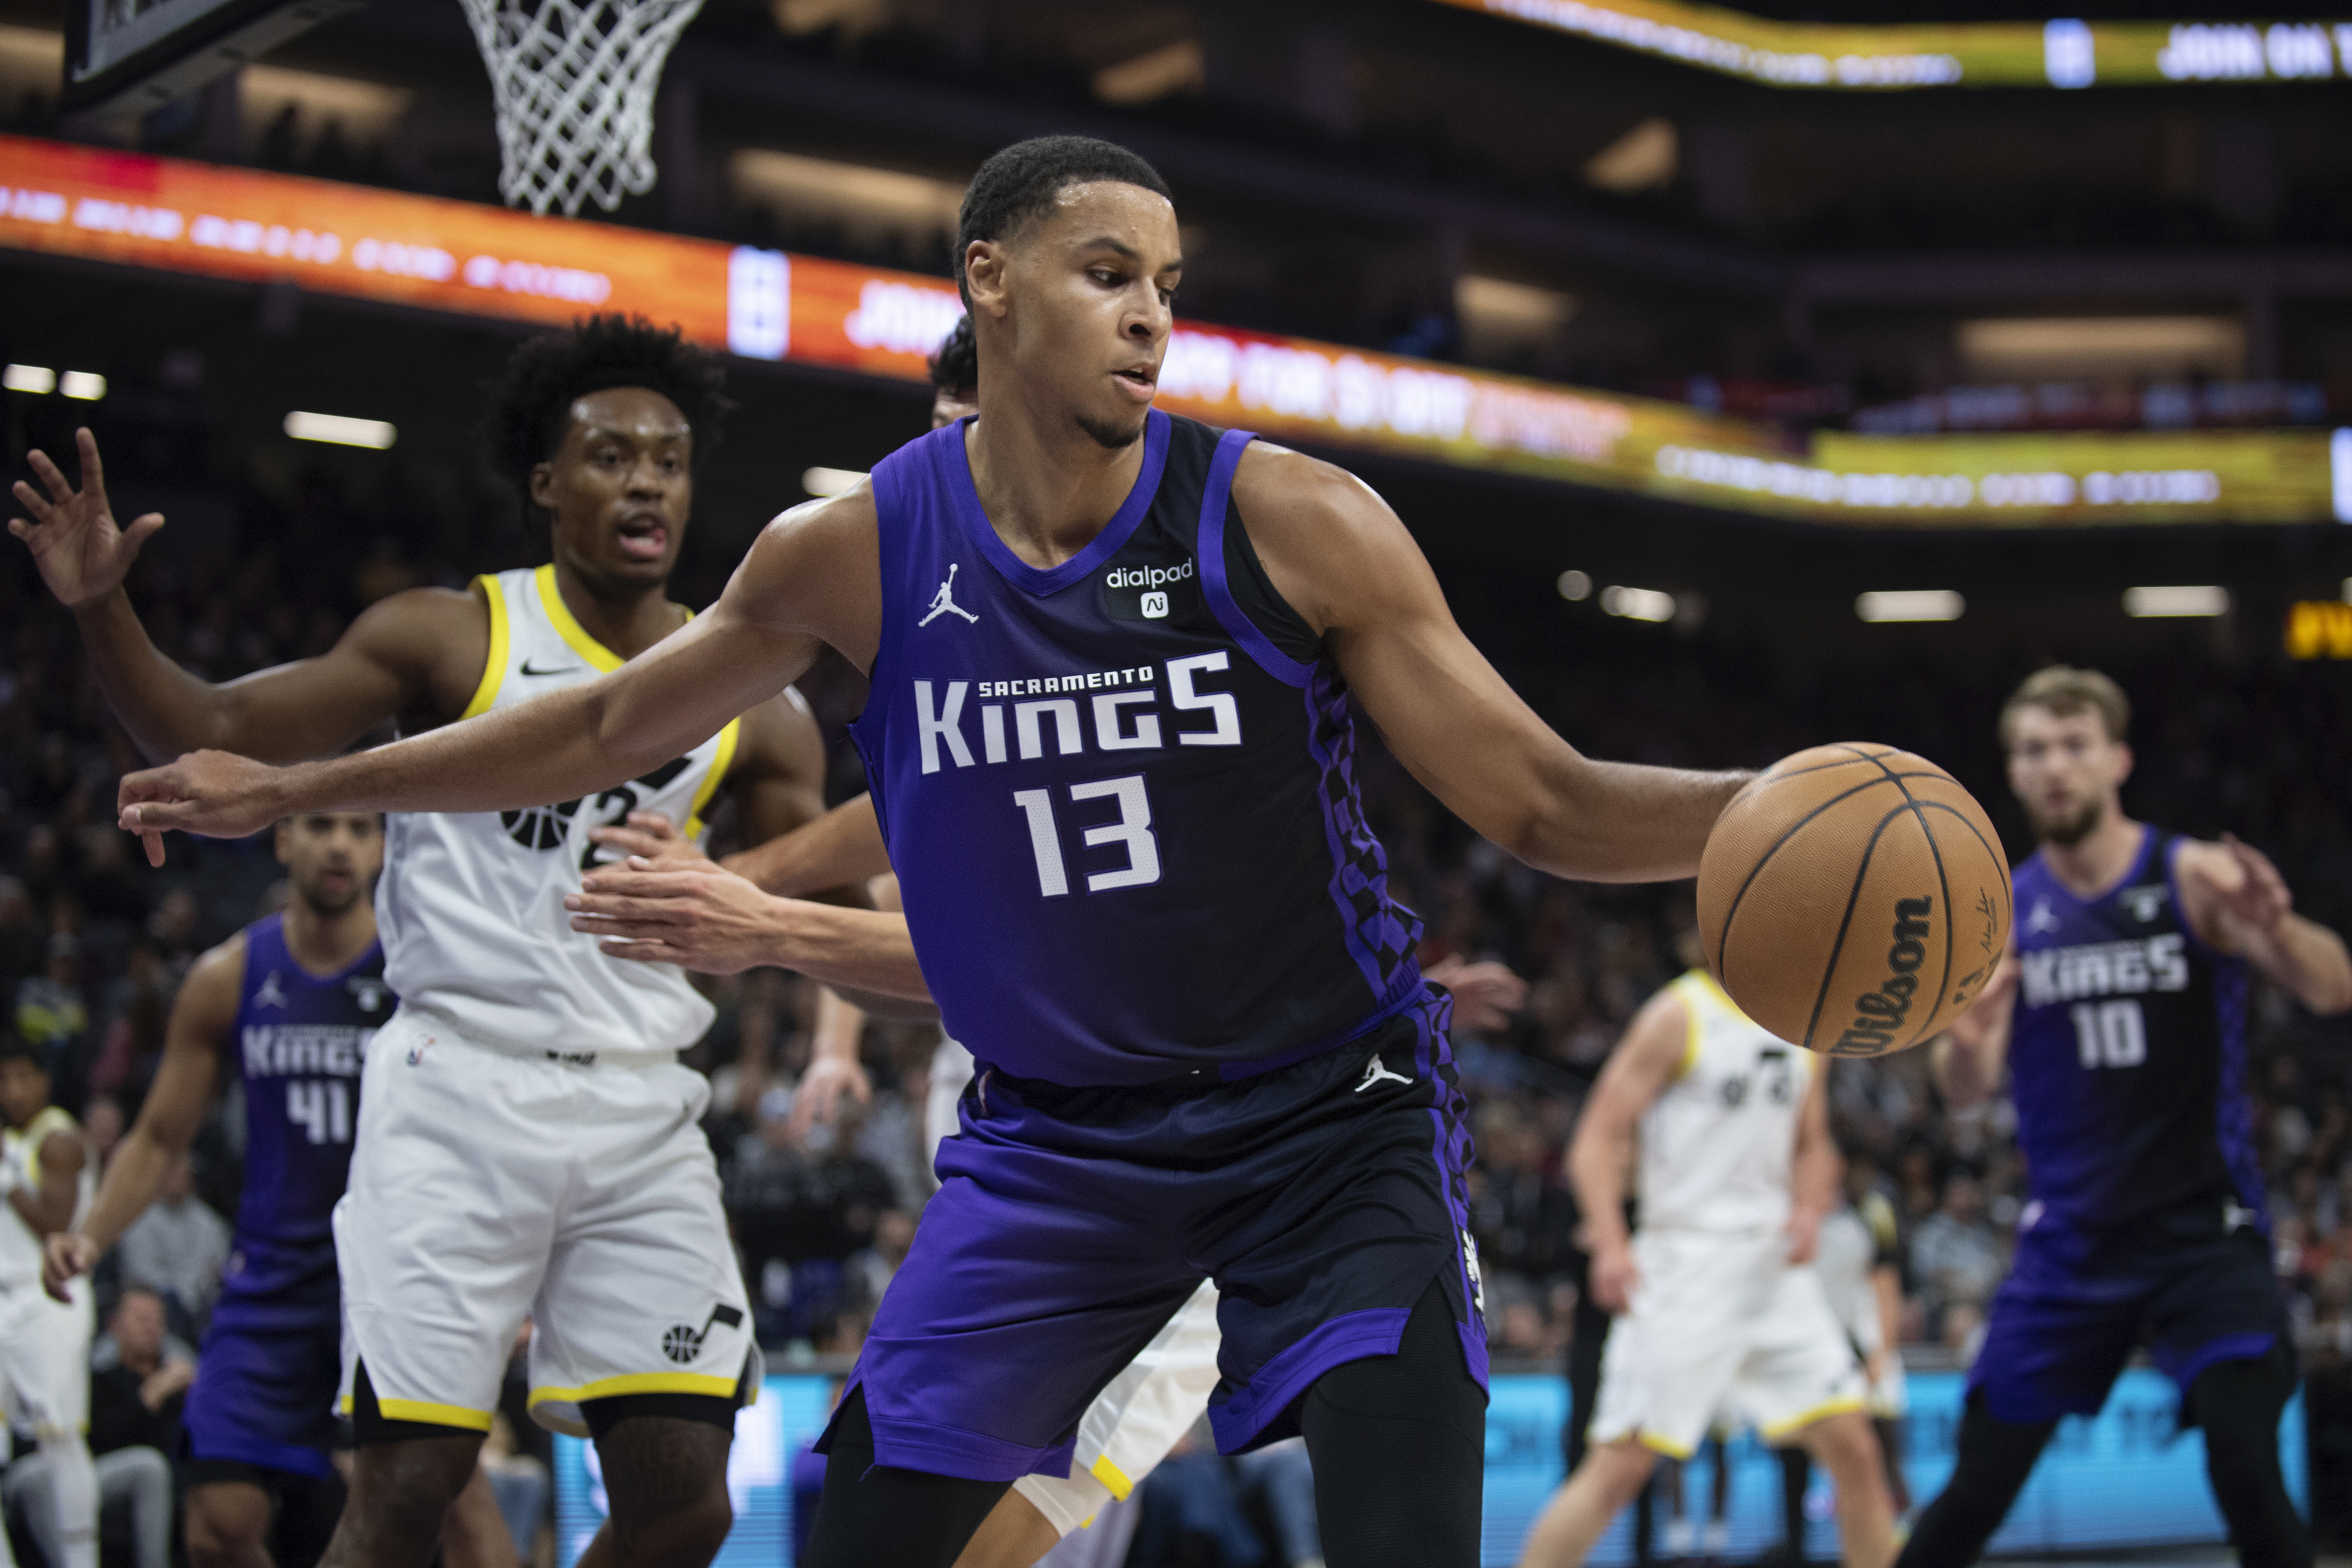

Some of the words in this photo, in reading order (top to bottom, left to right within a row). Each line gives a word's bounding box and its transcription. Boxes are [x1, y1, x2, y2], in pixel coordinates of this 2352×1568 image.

[1106, 557, 1193, 589] dialpad
[979, 666, 1153, 697] SACRAMENTO
[1014, 773, 1163, 897] 13
[1829, 894, 1932, 1054] Wilson
[2069, 998, 2147, 1070] 10
[286, 1079, 352, 1144] 41
